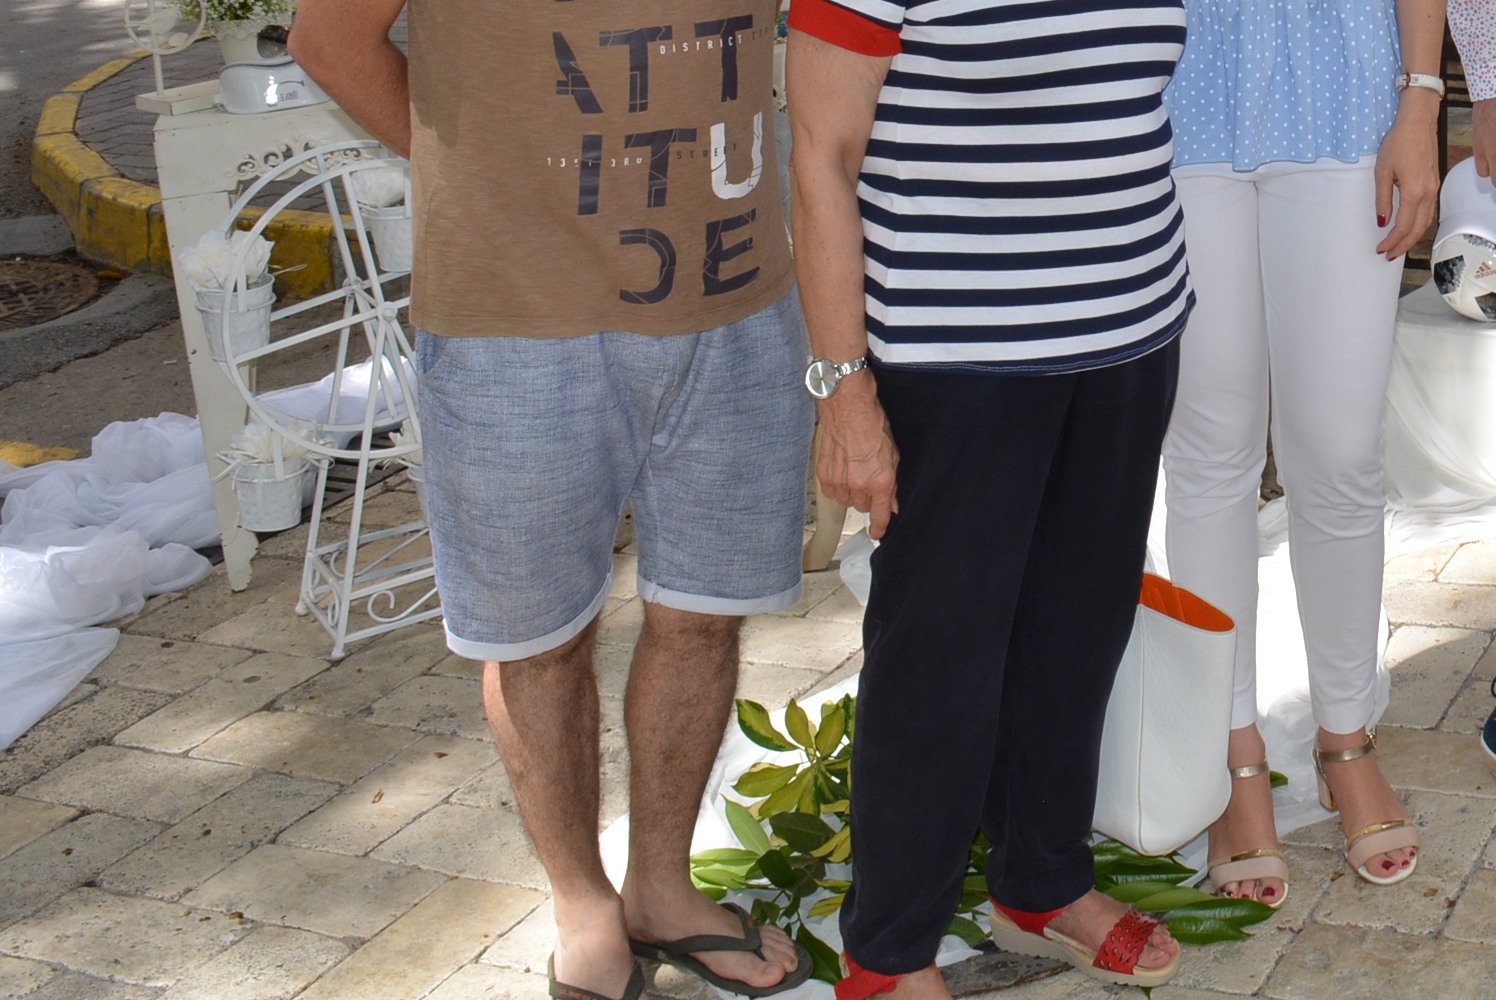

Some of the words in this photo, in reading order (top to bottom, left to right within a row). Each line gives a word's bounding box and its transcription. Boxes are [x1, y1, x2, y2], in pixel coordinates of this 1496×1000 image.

[659, 34, 743, 55] DISTRICT
[676, 142, 738, 160] STREET
[1474, 269, 1496, 279] adidas
